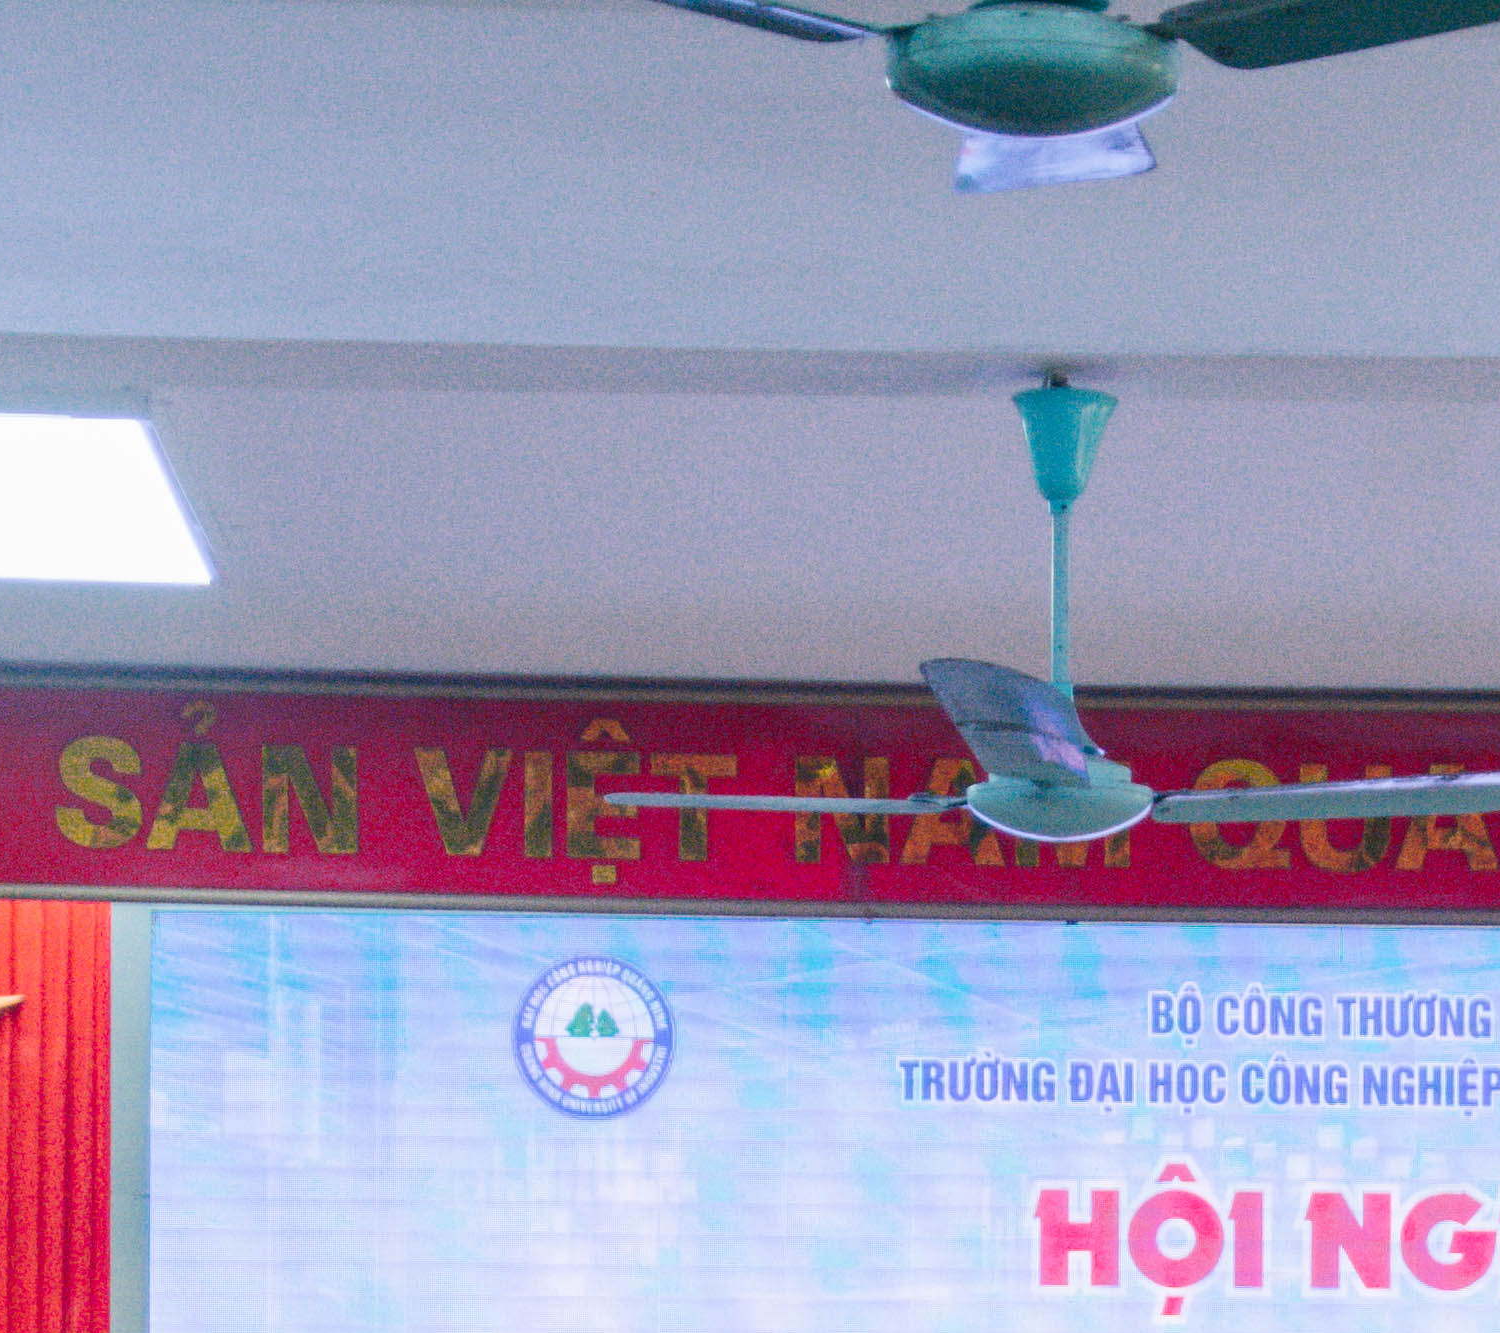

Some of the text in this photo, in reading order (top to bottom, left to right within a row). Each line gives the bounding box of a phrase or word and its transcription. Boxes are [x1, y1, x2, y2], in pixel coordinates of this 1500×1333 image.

[55, 700, 358, 855] SẢN
[414, 718, 737, 885] VIỆT
[1152, 984, 1492, 1045] BỘ CÔNG THƯƠNG
[901, 1051, 1056, 1103] TRƯỜNG
[1069, 1063, 1134, 1112] ĐẠI
[1150, 1065, 1226, 1114] HỌC
[1242, 1055, 1348, 1105] CÔNG
[1036, 1164, 1263, 1316] HỘI
